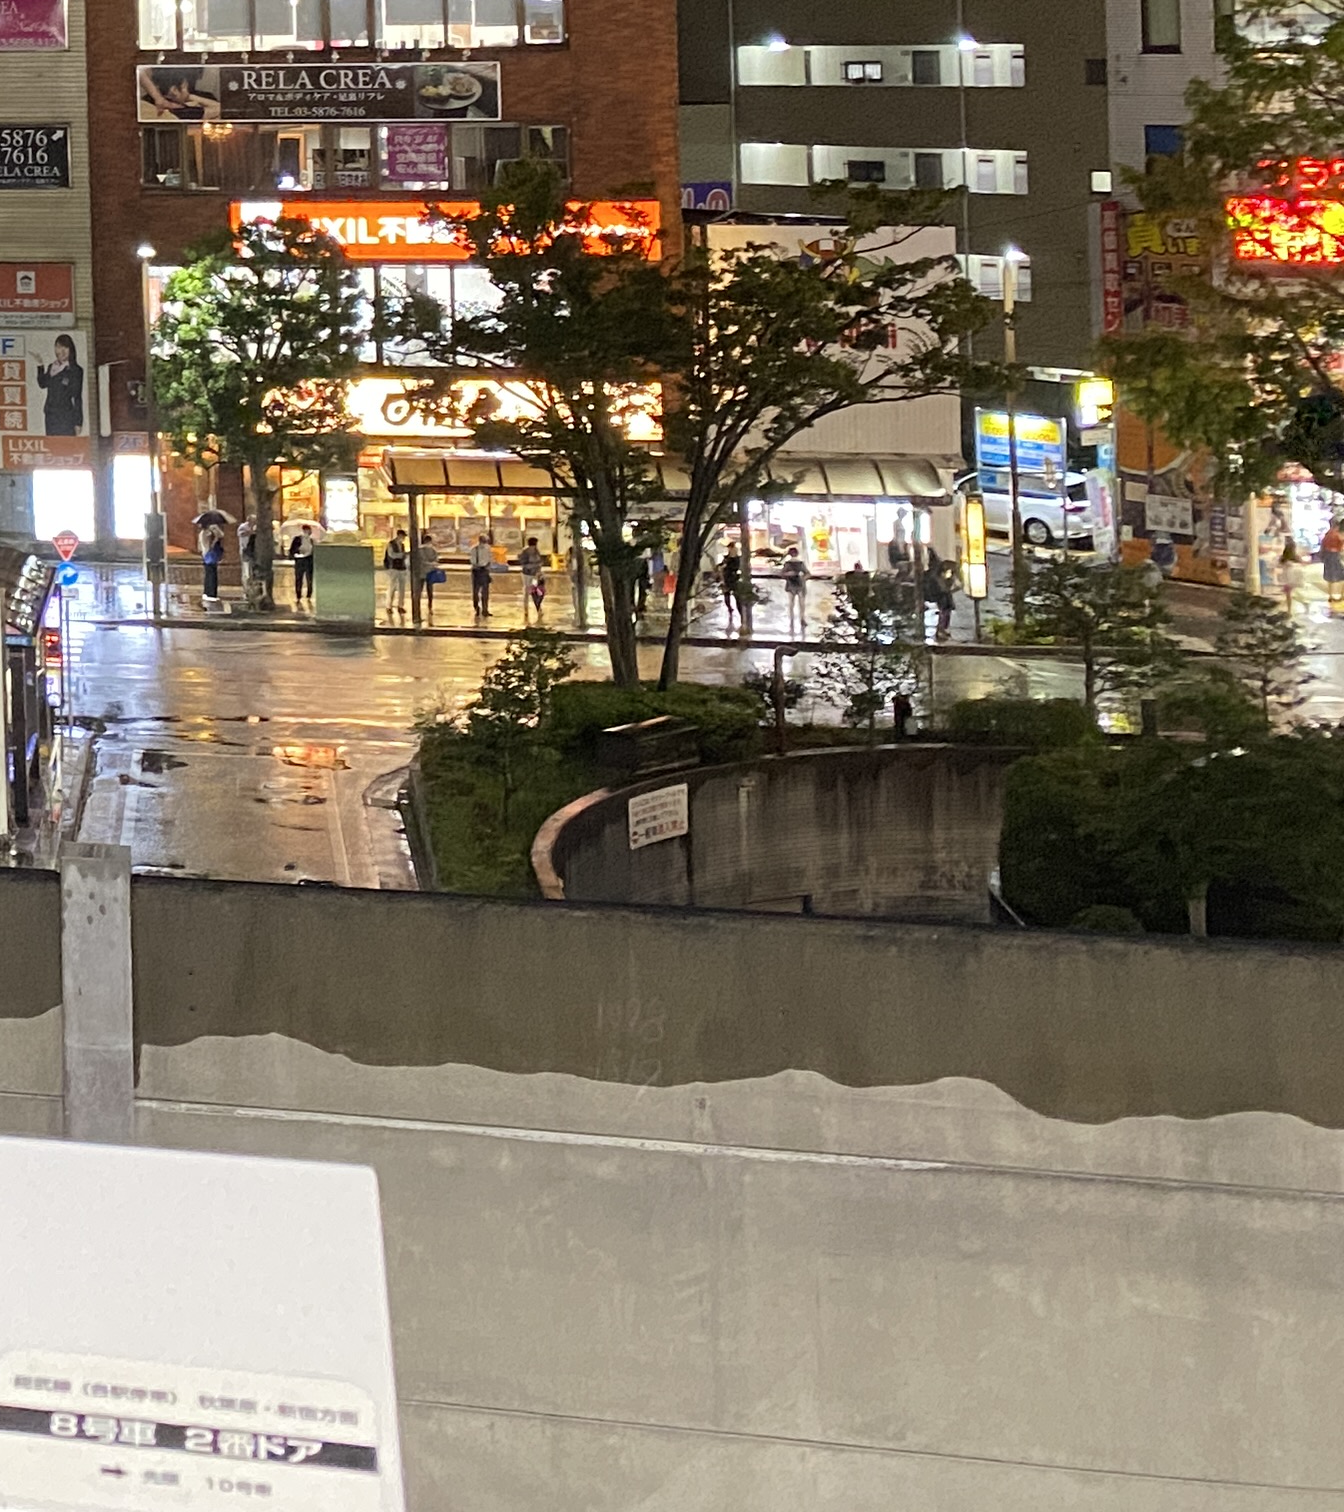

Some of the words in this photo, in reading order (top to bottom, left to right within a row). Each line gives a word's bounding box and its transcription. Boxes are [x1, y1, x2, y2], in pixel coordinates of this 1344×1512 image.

[242, 70, 313, 89] RELA
[319, 70, 393, 89] CREA
[1, 148, 48, 164] 7616
[24, 166, 61, 177] CREA
[9, 439, 50, 452] LIXIL
[50, 1412, 157, 1446] 8号車
[185, 1427, 323, 1464] 2番ドア
